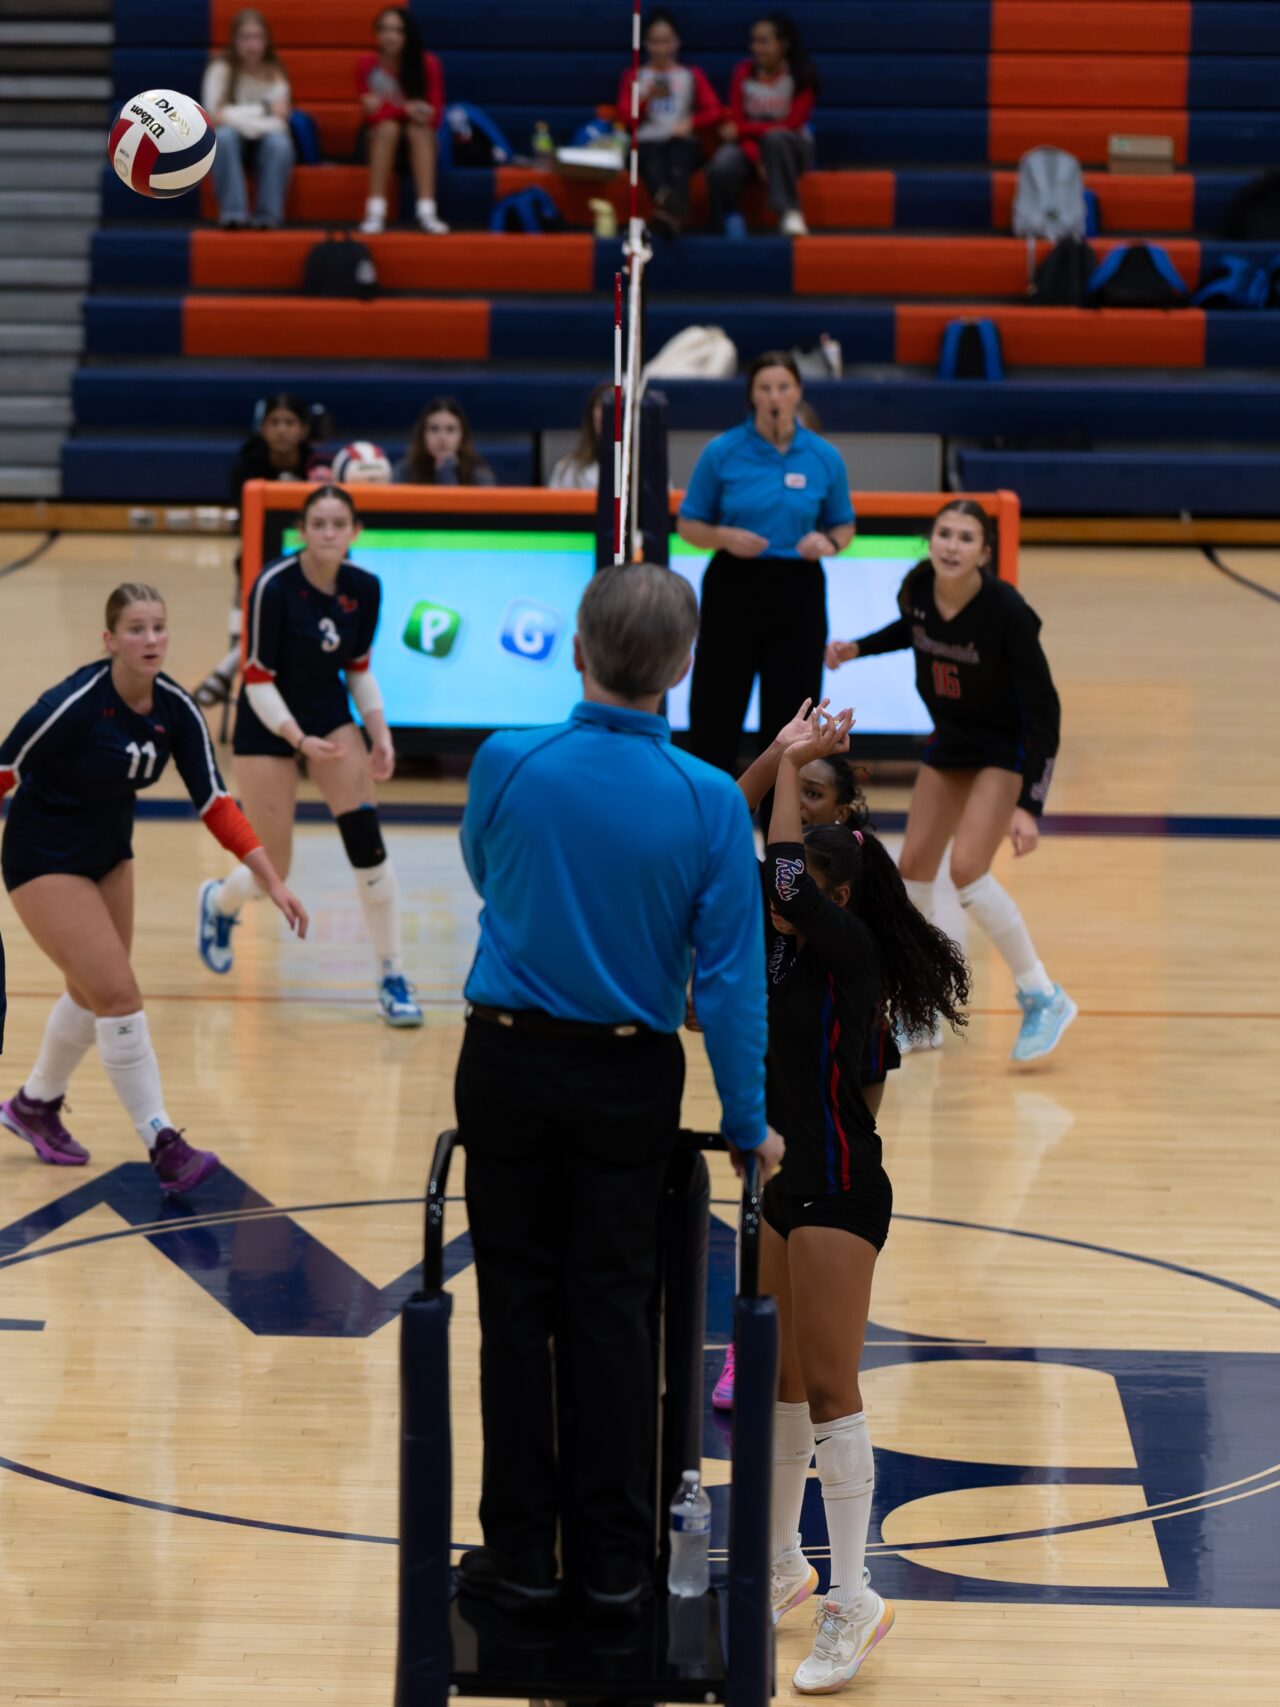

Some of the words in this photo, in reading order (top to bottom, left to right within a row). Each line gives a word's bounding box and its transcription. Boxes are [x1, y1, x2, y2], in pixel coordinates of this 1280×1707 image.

[130, 104, 165, 139] Wilson
[318, 617, 340, 652] 3
[421, 610, 450, 653] P
[513, 611, 544, 654] G
[933, 661, 961, 699] 16
[125, 740, 157, 779] 11
